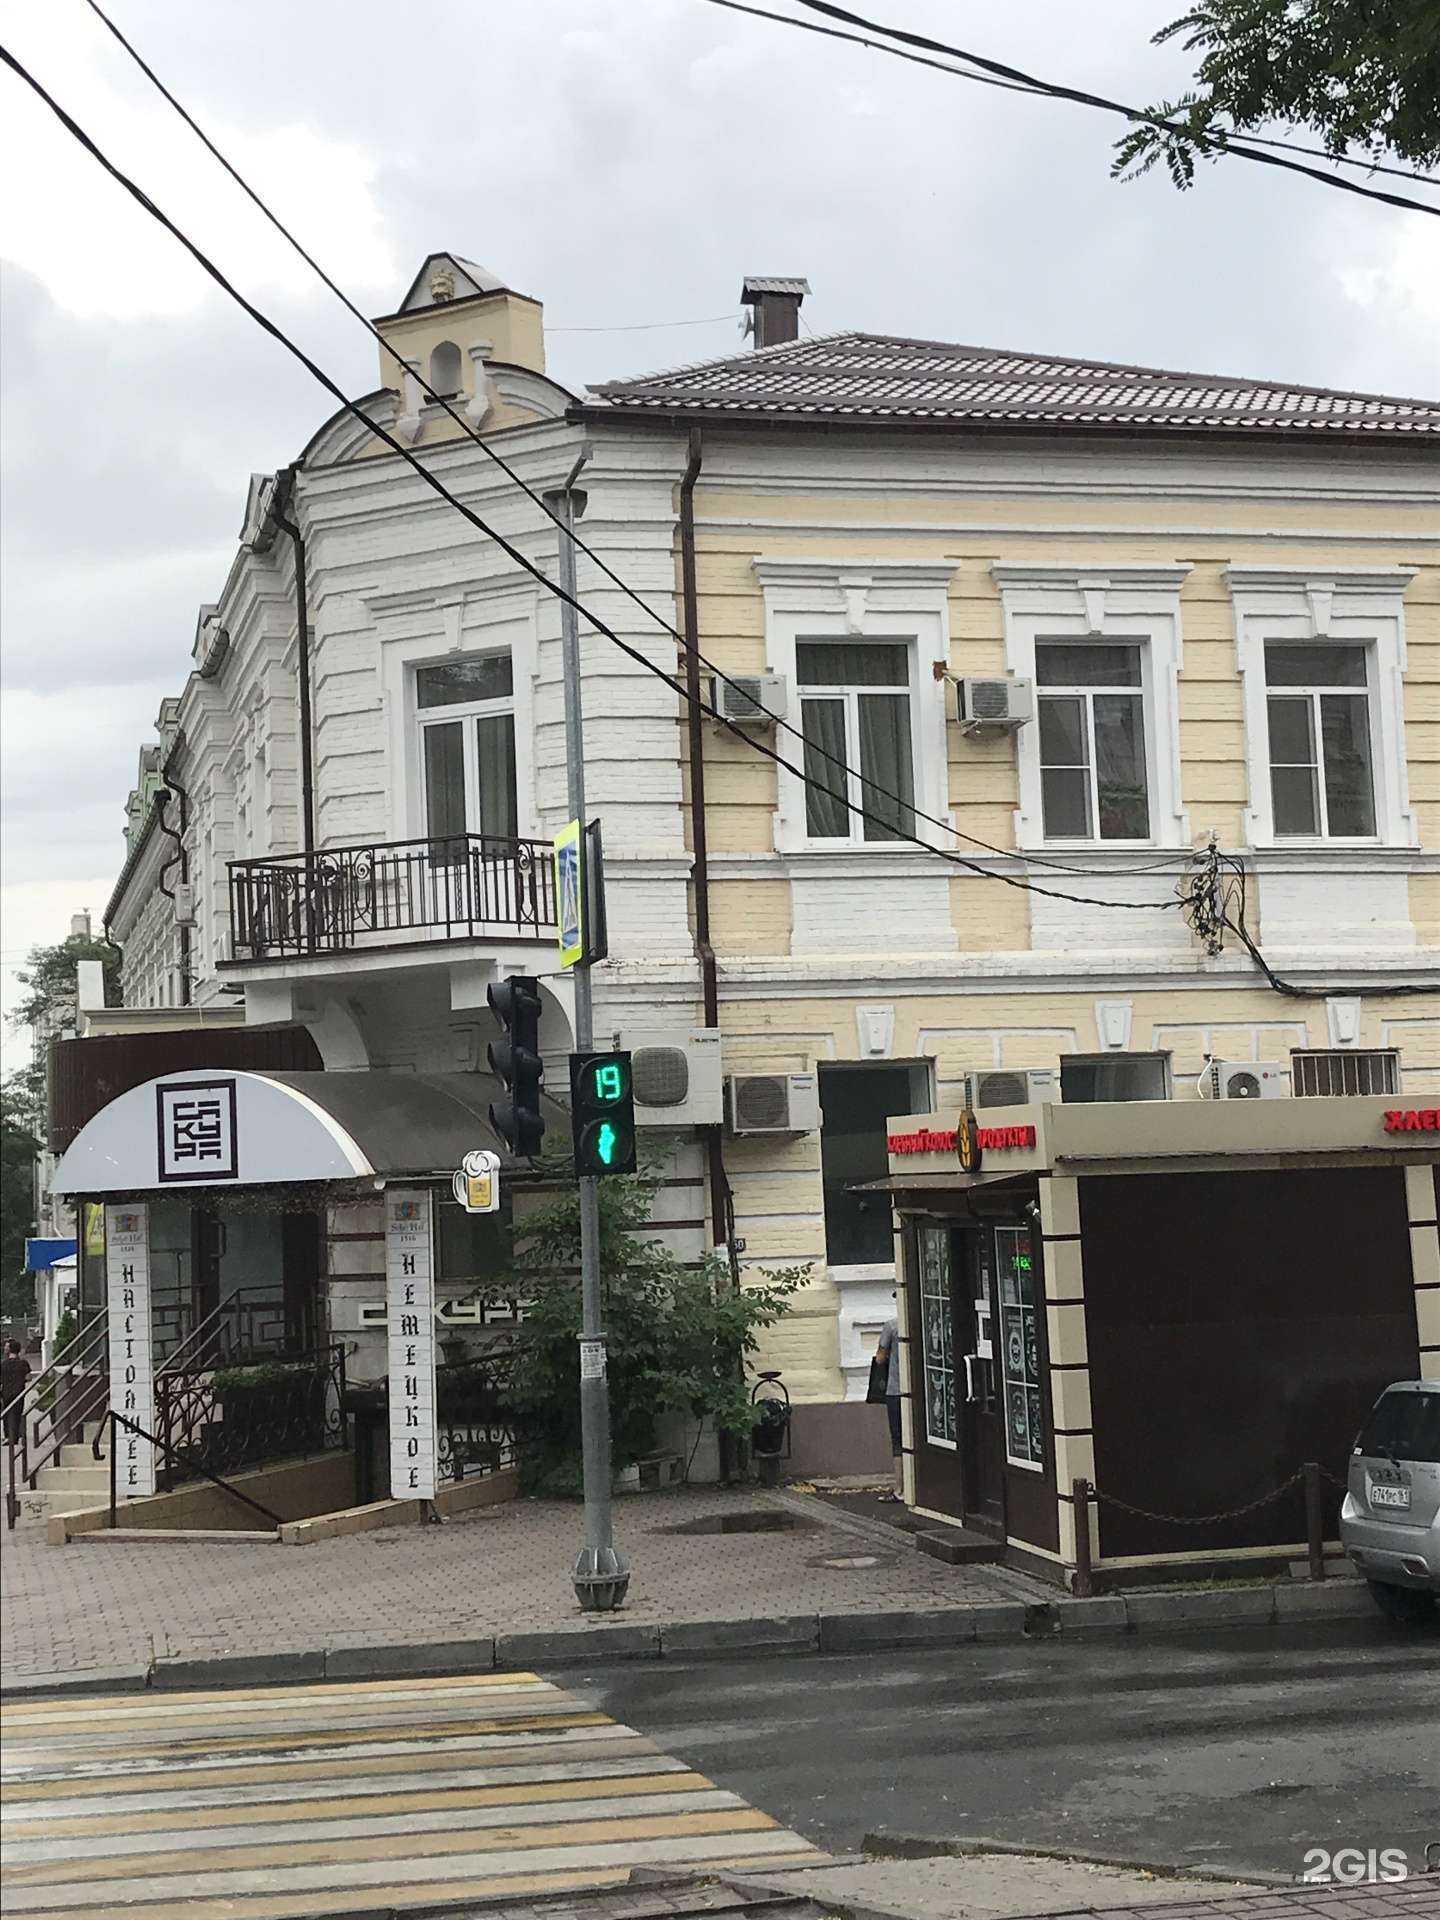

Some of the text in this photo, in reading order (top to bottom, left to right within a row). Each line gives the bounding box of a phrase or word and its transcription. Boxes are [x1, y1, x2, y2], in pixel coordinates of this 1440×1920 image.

[596, 1066, 621, 1099] 19
[1383, 1109, 1440, 1131] ХЛЕ
[401, 1253, 419, 1489] НЕМЕЦКОЕ
